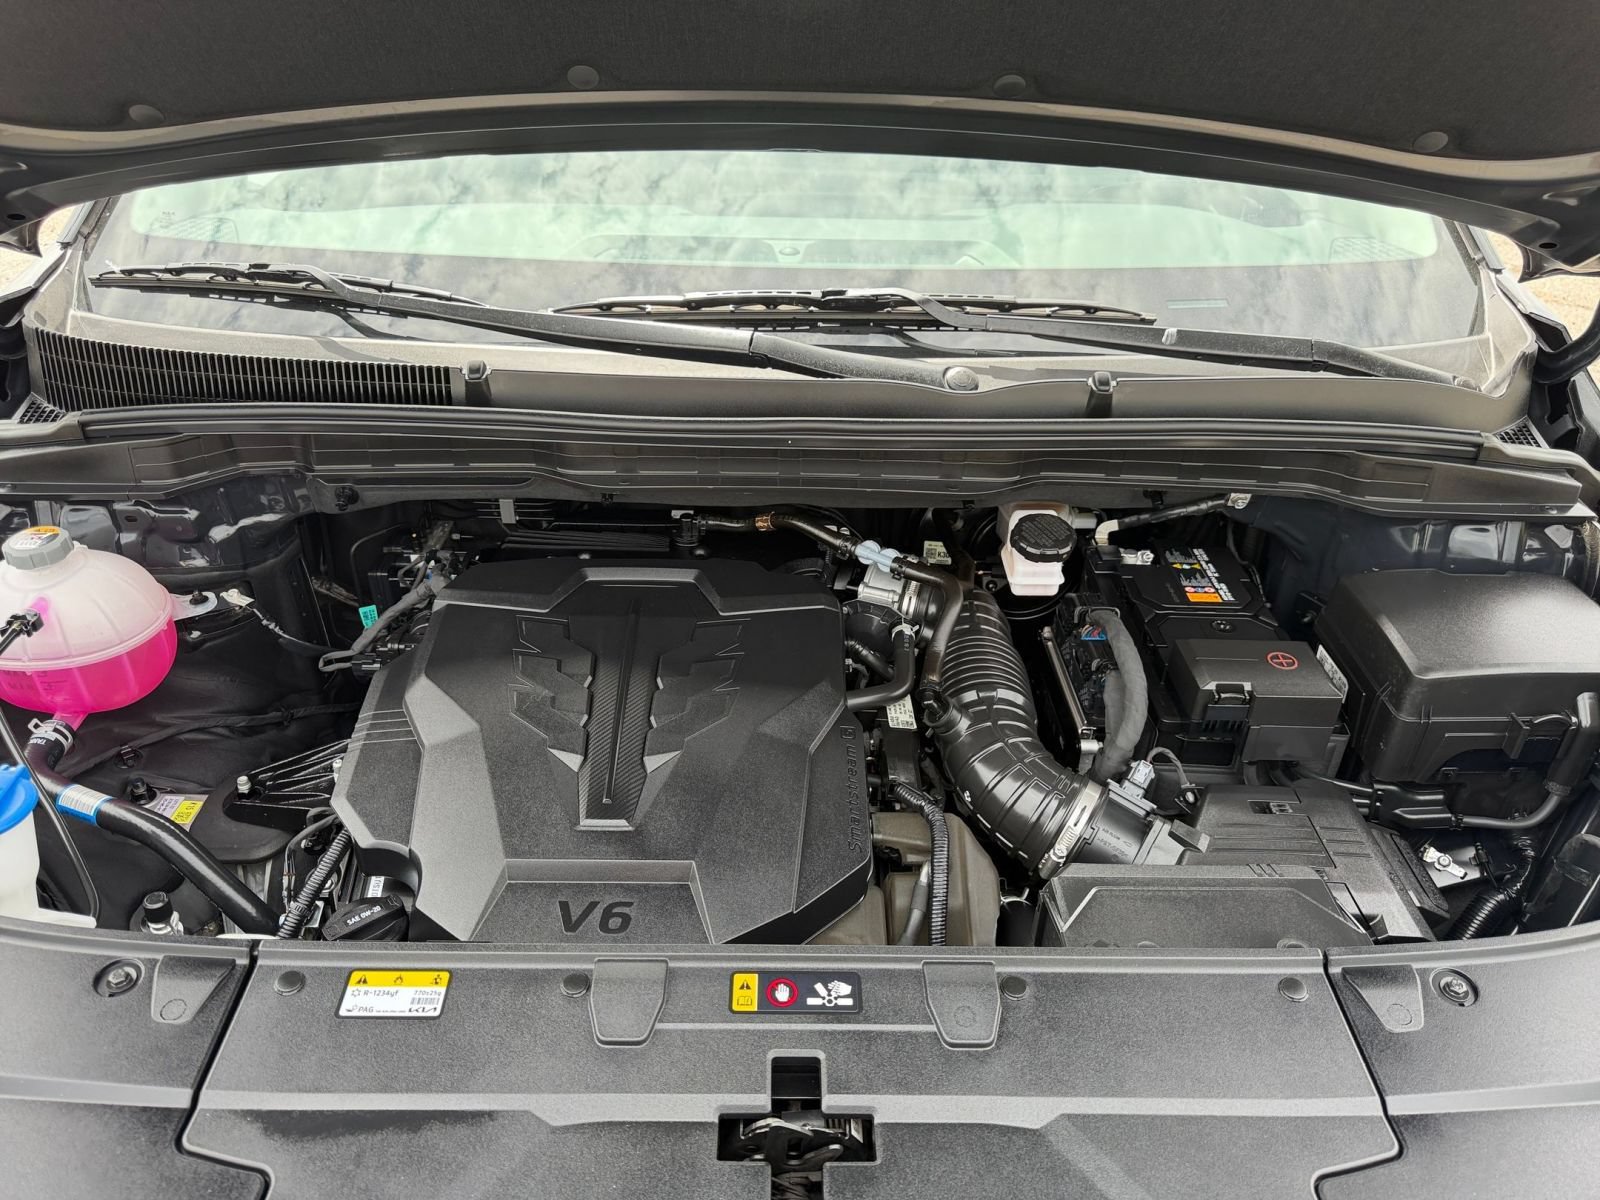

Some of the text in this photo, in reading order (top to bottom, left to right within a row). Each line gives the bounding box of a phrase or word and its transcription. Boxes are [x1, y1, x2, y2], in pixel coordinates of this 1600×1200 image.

[846, 743, 861, 851] Smartstream
[346, 905, 381, 926] SAE 0W-20
[558, 900, 634, 935] V6
[363, 989, 400, 997] R-1234yf
